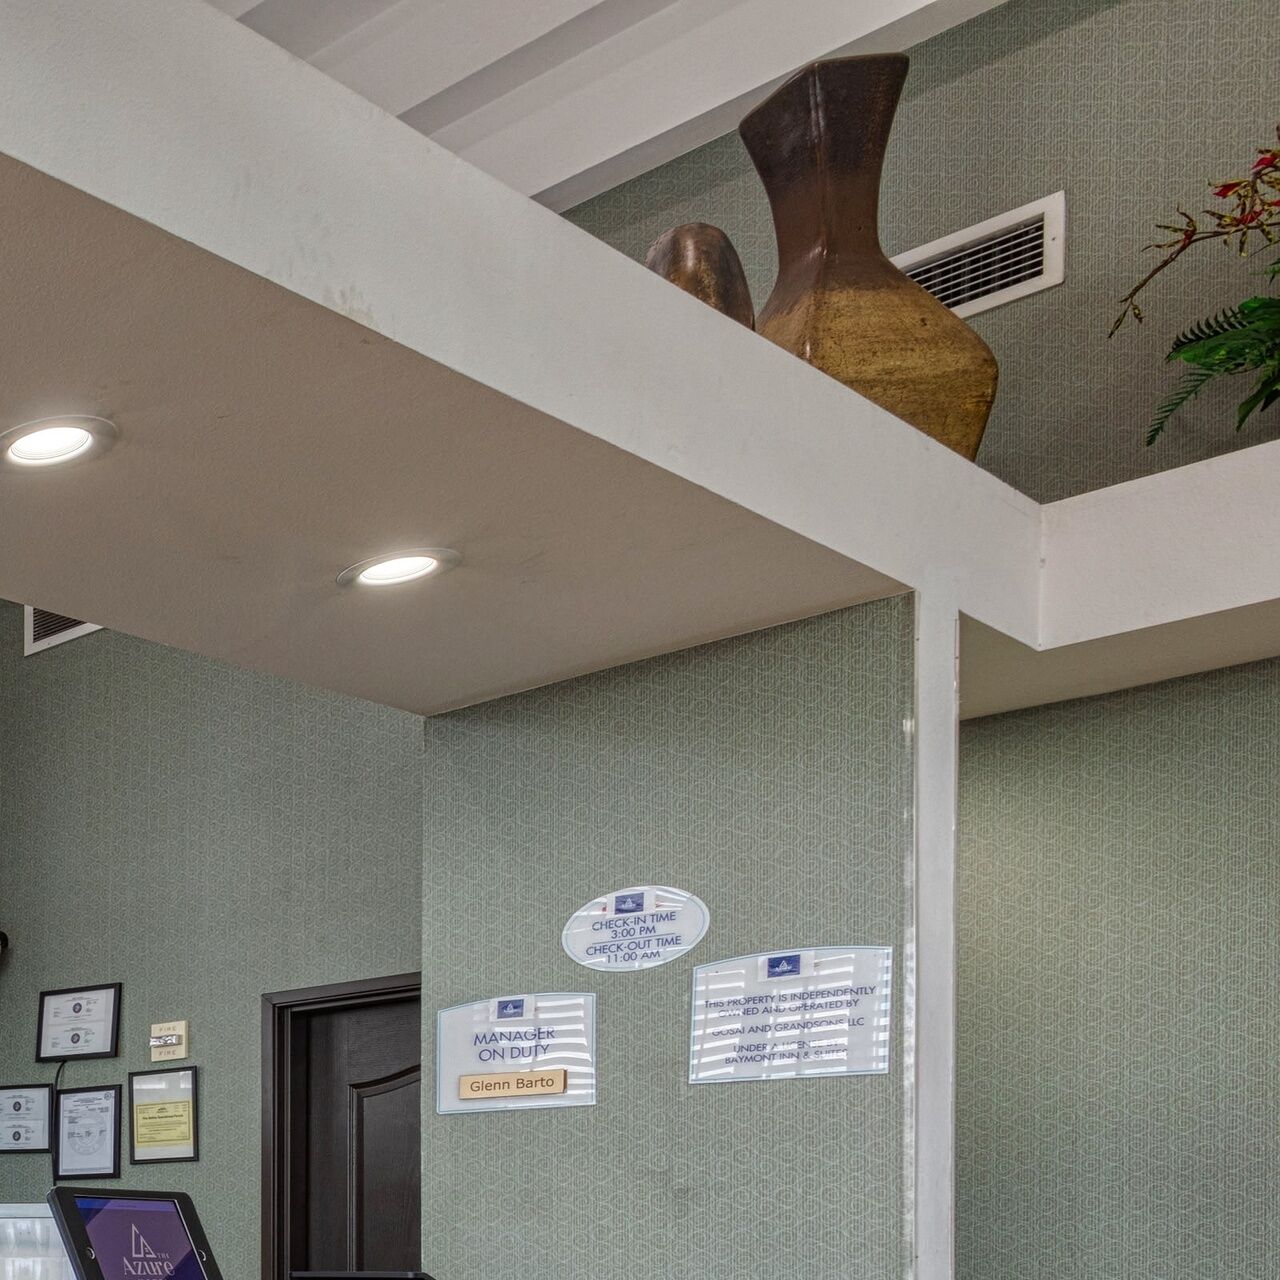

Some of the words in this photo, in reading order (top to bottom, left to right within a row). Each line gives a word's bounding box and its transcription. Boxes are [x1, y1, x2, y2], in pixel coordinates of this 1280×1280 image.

[591, 915, 646, 931] CHECK-IN
[650, 911, 676, 925] TIME
[611, 927, 635, 939] 3:00
[639, 925, 656, 936] PM
[585, 939, 651, 956] CHECK-OUT
[656, 935, 682, 949] TIME
[606, 951, 638, 964] 11:00
[641, 950, 661, 960] AM
[704, 999, 725, 1009] THIS
[727, 995, 776, 1007] PROPERTY
[778, 993, 788, 1002] IS
[790, 986, 877, 1001] INDEPENDENTLY
[718, 1005, 759, 1017] OWNED
[762, 1004, 786, 1014] AND
[788, 1000, 843, 1012] OPERATED
[846, 998, 860, 1008] BY
[747, 1023, 772, 1033] AND
[774, 1018, 845, 1032] GRANDSONS
[847, 1017, 865, 1027] LLC
[473, 1027, 556, 1046] MANAGER
[478, 1048, 505, 1062] ON
[510, 1044, 550, 1060] DUTY
[733, 1042, 768, 1053] UNDER
[725, 1053, 777, 1064] BAYMONT
[779, 1051, 800, 1061] INN
[802, 1050, 810, 1060] &
[470, 1080, 510, 1092] Glenn
[516, 1077, 555, 1089] Barto
[123, 1256, 176, 1276] Azure
